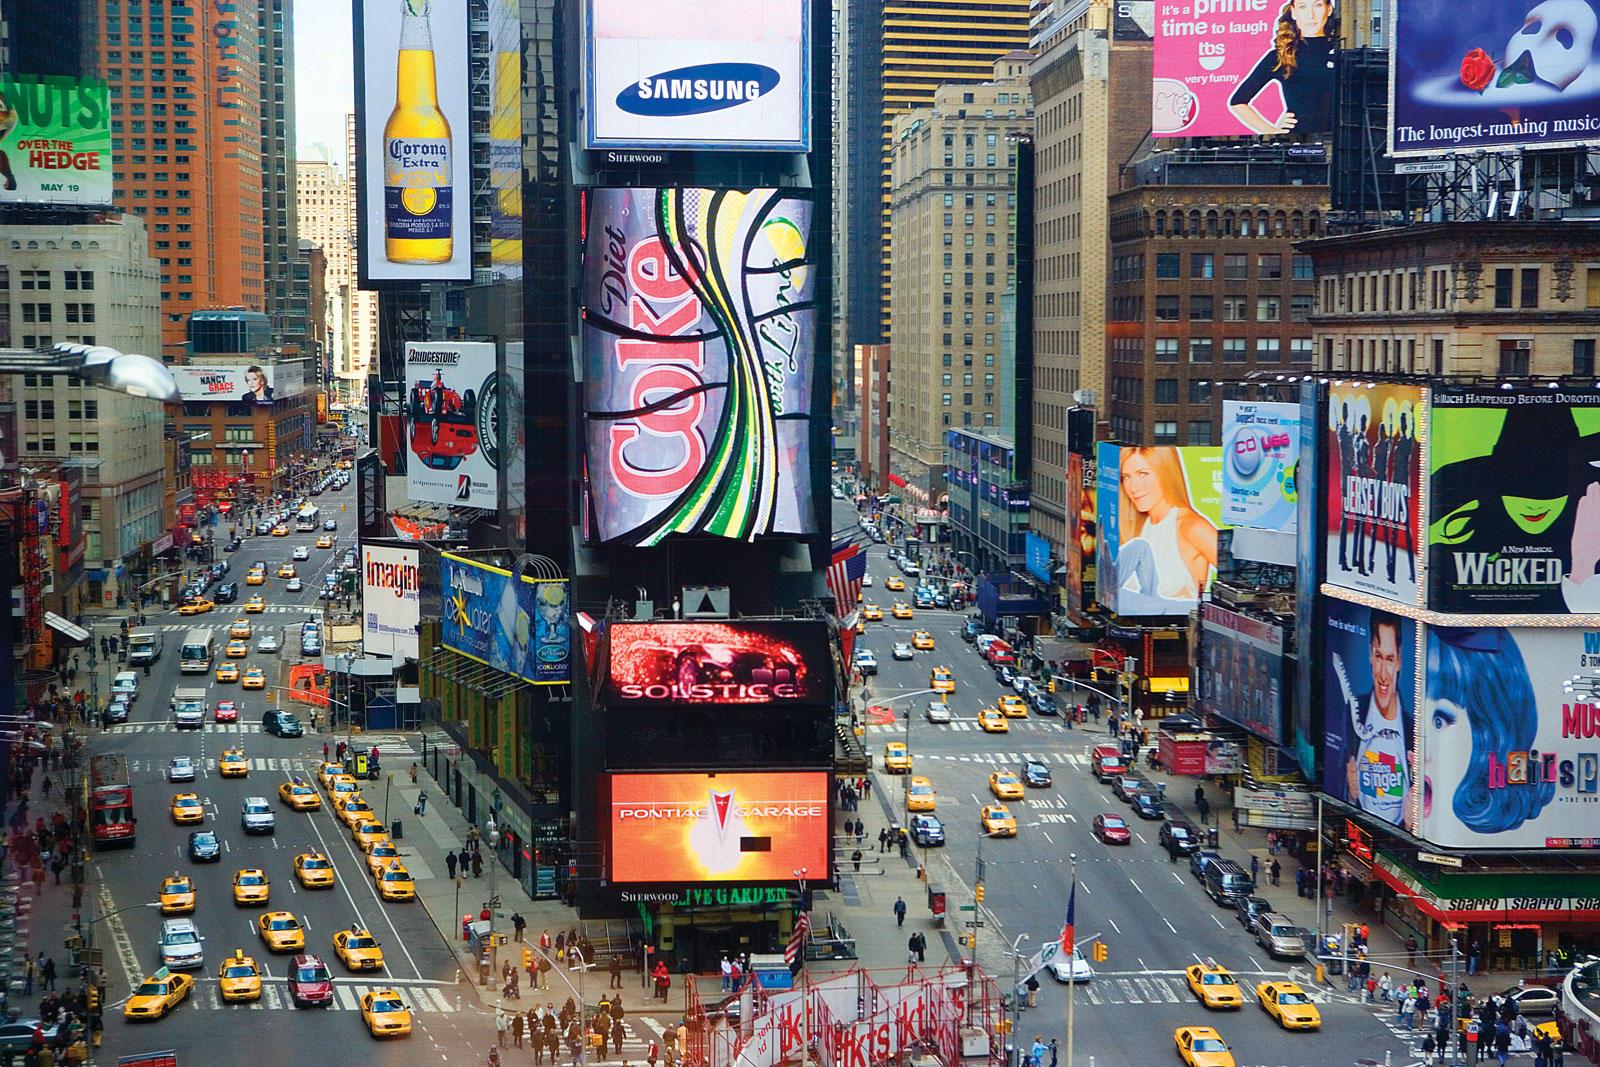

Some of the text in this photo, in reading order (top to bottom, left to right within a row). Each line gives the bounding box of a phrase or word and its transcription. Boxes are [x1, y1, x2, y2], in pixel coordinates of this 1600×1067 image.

[1162, 5, 1179, 15] it's
[1162, 19, 1268, 36] time to laugh
[1198, 42, 1225, 55] tbs
[1184, 73, 1239, 85] very funny
[638, 78, 760, 100] SAMSUNG
[3, 71, 108, 130] NUTS!
[1397, 127, 1425, 142] The
[1430, 119, 1548, 142] longest-running
[17, 140, 73, 152] OVER THE
[389, 138, 447, 160] Corona
[29, 150, 101, 170] HEDGE
[402, 157, 439, 168] Extra
[608, 152, 662, 163] SHERWOOD
[41, 183, 80, 192] MAY 19
[601, 225, 629, 316] Diet
[760, 256, 797, 373] Lime
[408, 348, 457, 364] BRIDGESTONE
[608, 234, 707, 499] Coke
[200, 375, 226, 385] NANCY
[208, 382, 235, 392] GRACE
[767, 359, 784, 417] with
[1465, 394, 1516, 405] HAPPENED
[1518, 394, 1553, 404] BEFORE
[1555, 393, 1600, 403] DOROTHY
[1344, 475, 1381, 517] JERSEY
[1381, 480, 1408, 525] BOYS
[1452, 552, 1562, 585] WICKED
[1581, 654, 1586, 667] 8
[621, 684, 795, 700] SOLSTICE
[1362, 772, 1403, 792] singer
[620, 806, 822, 819] PONTIAC GARAGE
[621, 891, 679, 902] SHERWOOD
[717, 886, 787, 903] GARDEN
[1449, 898, 1499, 911] sbarro
[1511, 898, 1562, 910] sbarro
